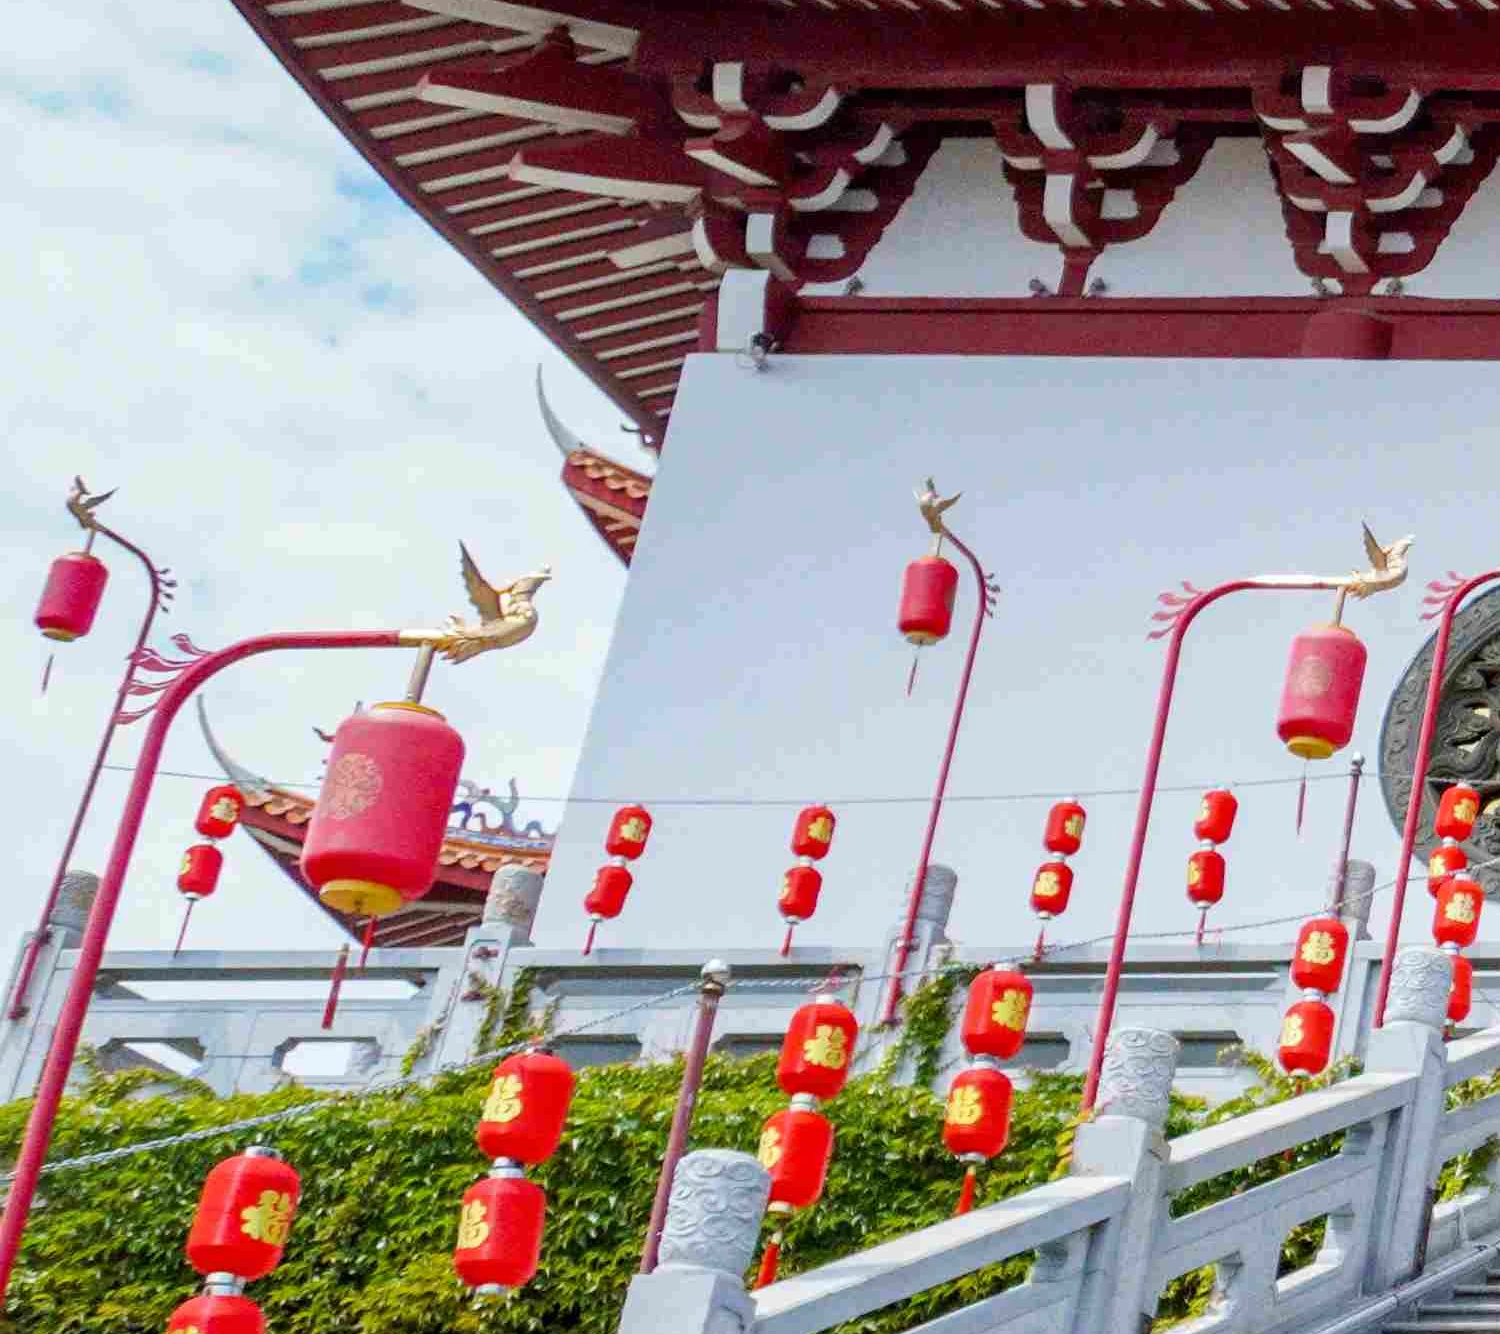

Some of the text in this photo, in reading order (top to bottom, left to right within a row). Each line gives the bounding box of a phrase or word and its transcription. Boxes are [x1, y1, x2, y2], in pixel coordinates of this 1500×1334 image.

[1445, 892, 1475, 924] 福
[1302, 931, 1335, 964] 福
[804, 1024, 847, 1069] 福
